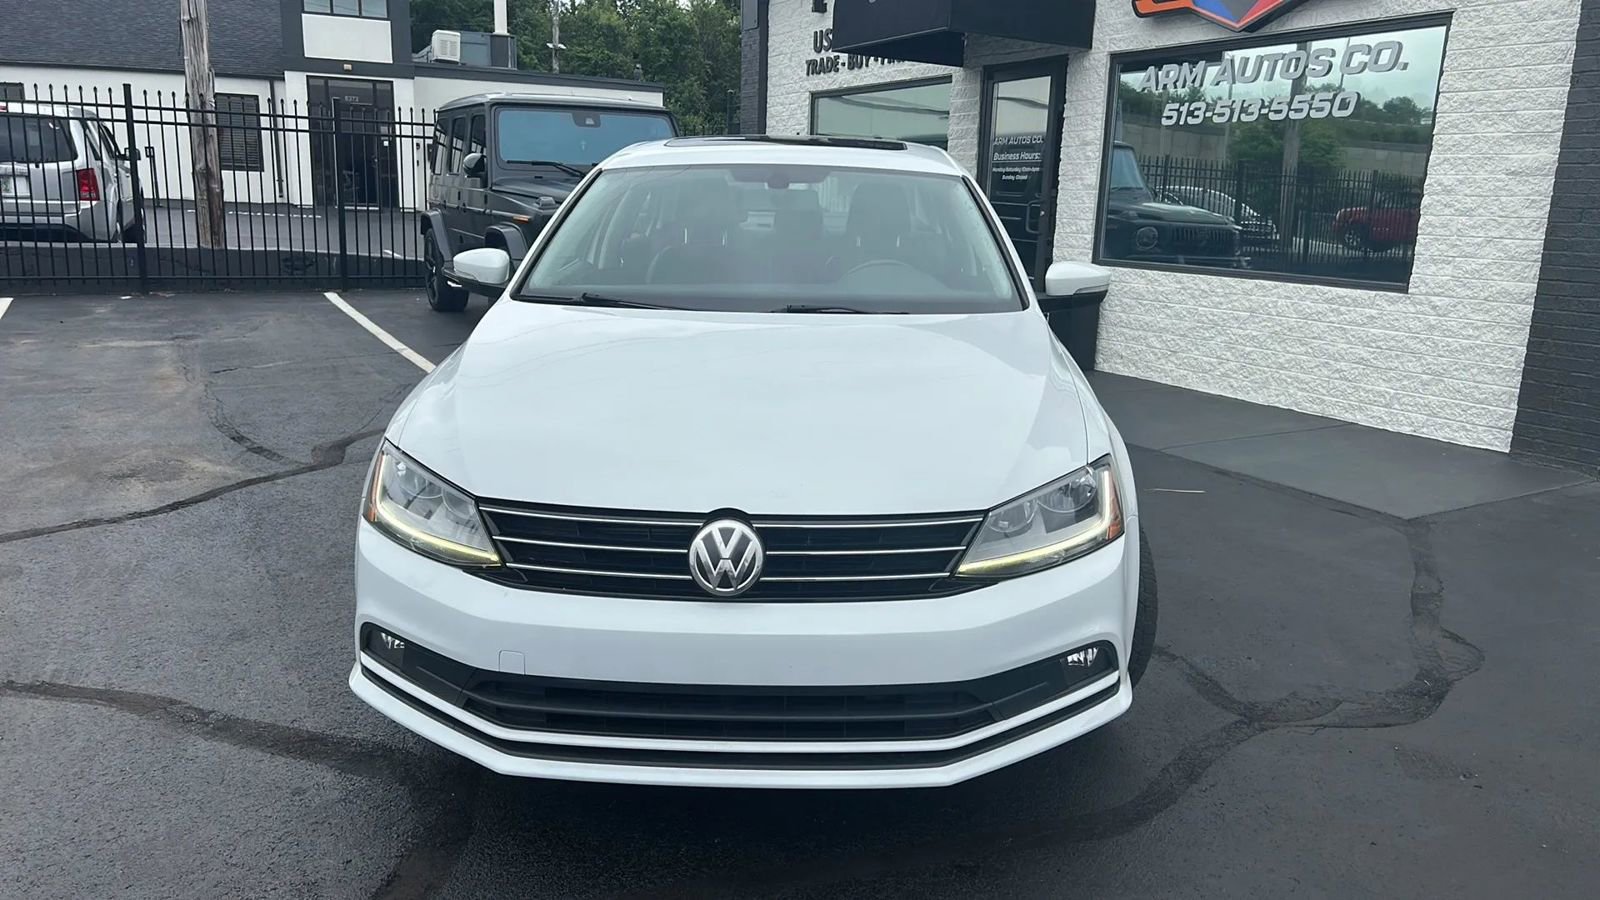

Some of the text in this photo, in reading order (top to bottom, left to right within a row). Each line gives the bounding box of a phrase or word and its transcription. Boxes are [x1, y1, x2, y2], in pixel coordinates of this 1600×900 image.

[805, 54, 840, 76] TRADE
[1138, 40, 1409, 92] ARM AUTOS CO.
[1161, 91, 1360, 126] 513-513-5550
[993, 136, 1007, 145] ARM
[1008, 135, 1031, 145] AUTOS
[993, 152, 1019, 160] Business
[689, 519, 764, 597] VW
